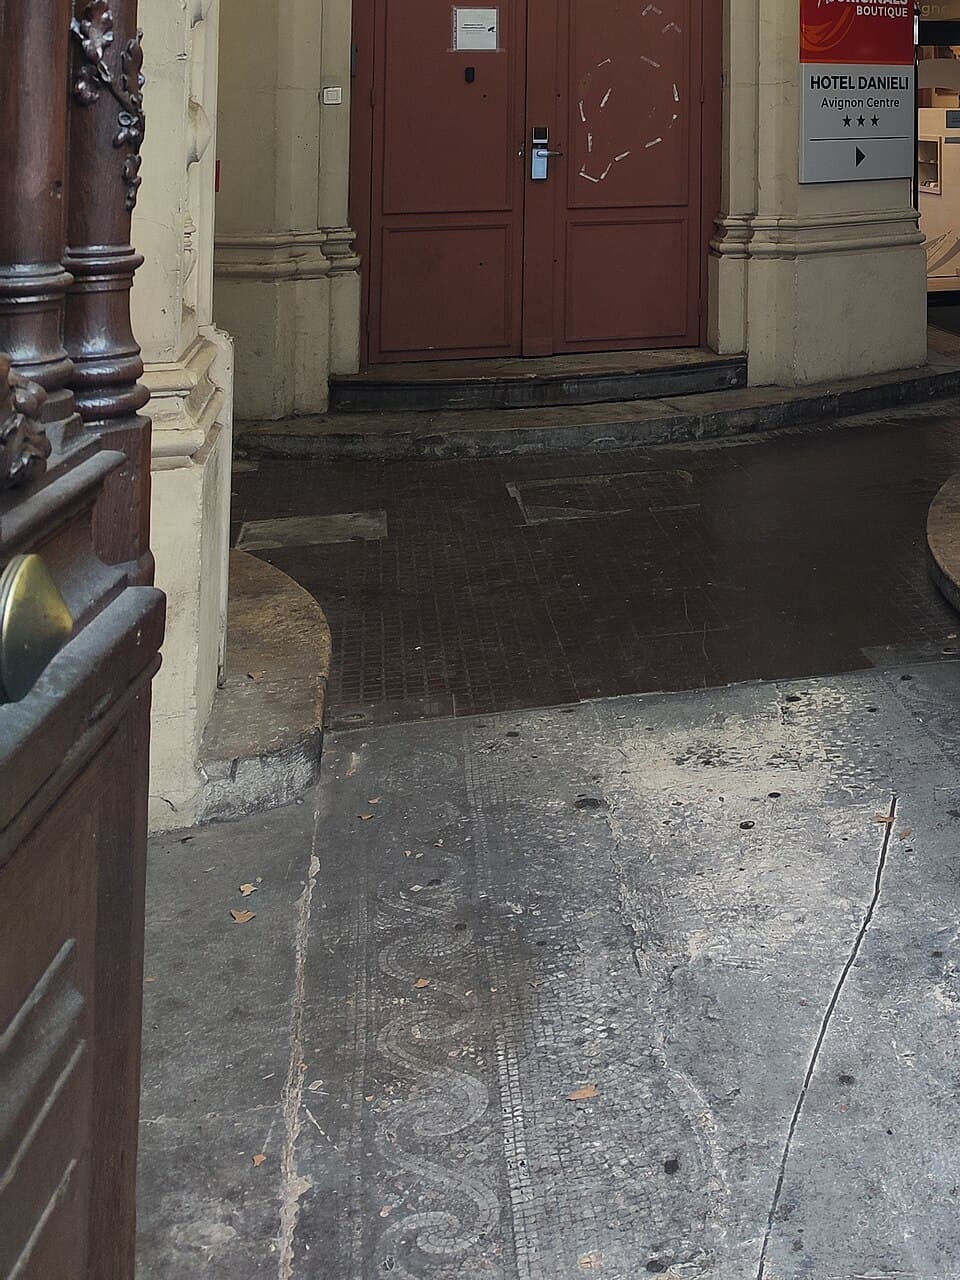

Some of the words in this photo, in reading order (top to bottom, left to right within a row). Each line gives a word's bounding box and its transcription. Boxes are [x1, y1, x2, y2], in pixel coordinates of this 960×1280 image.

[856, 5, 908, 18] BOUTIQUE
[810, 75, 855, 90] HOTEL
[858, 76, 909, 90] DANIELI
[821, 97, 864, 111] Avignon
[866, 97, 900, 108] Centre
